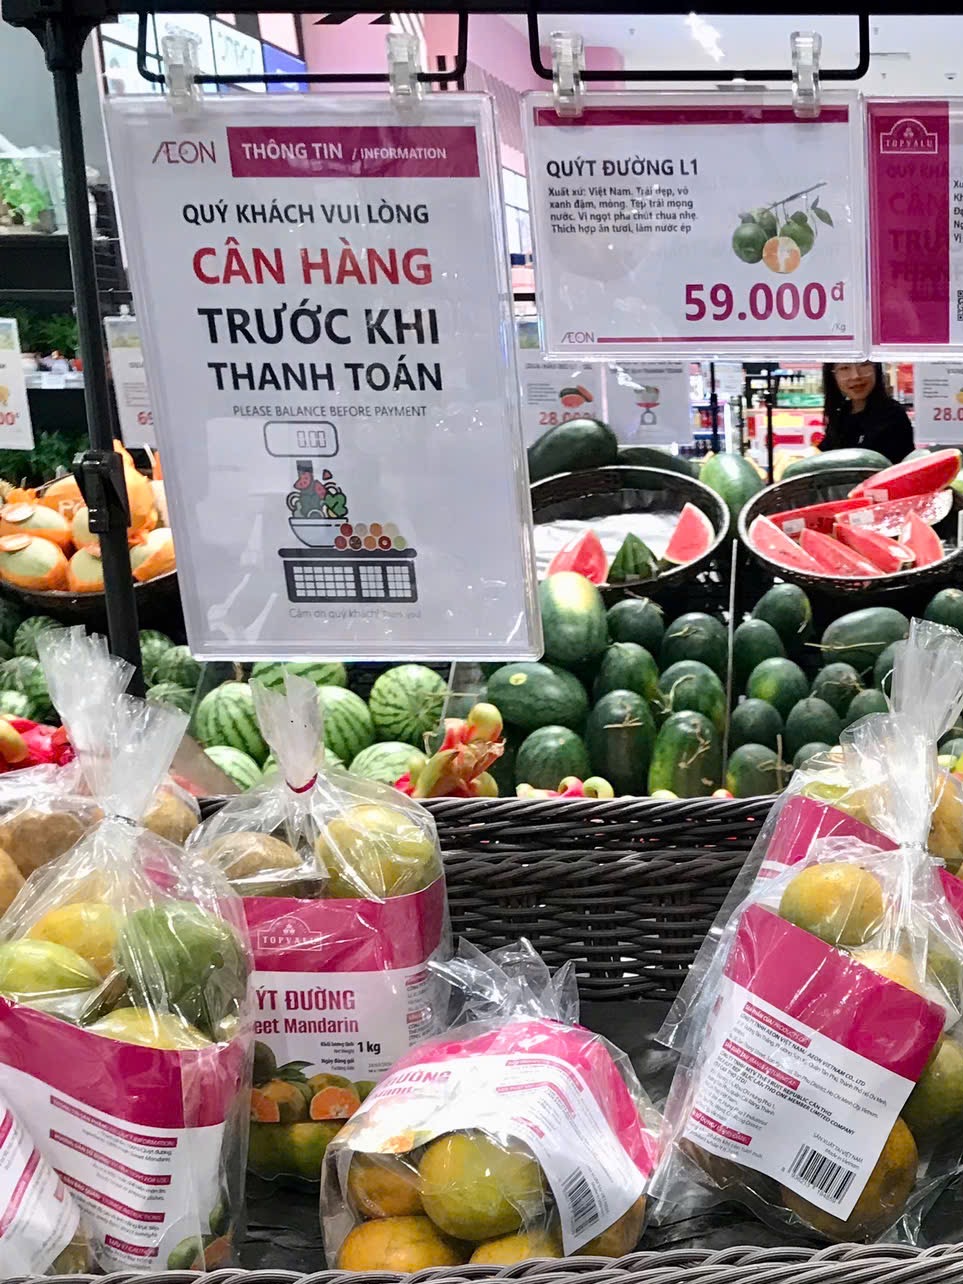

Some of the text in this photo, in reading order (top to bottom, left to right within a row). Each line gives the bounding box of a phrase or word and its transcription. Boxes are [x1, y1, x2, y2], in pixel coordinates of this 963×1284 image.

[242, 138, 447, 160] THÔNG TIN INFORMATION
[546, 155, 698, 178] QUÝT ĐƯỜNG L1
[548, 186, 633, 198] Xuất Việt Nam.
[182, 198, 429, 227] QUÝ KHÁCH VUI LÒNG
[550, 199, 571, 209] xanh
[667, 199, 694, 211] mọng
[590, 213, 611, 224] ngọt
[655, 212, 677, 222] chua
[578, 224, 596, 235] hợp
[655, 223, 678, 233] nước
[680, 223, 692, 235] ép
[192, 236, 433, 286] CÂN HÀNG
[197, 298, 440, 345] TRƯỚC KHI
[207, 354, 443, 391] THANH TOÁN
[233, 405, 427, 417] PLEASE BALANCE BEFORE PAYMENT
[285, 986, 356, 1011] ĐƯỜNG
[254, 1017, 359, 1035] eet Mandarin
[357, 1042, 364, 1053] 1
[366, 1041, 381, 1055] kg
[783, 1084, 809, 1103] REPUBLIC
[830, 1118, 856, 1136] COMPANY
